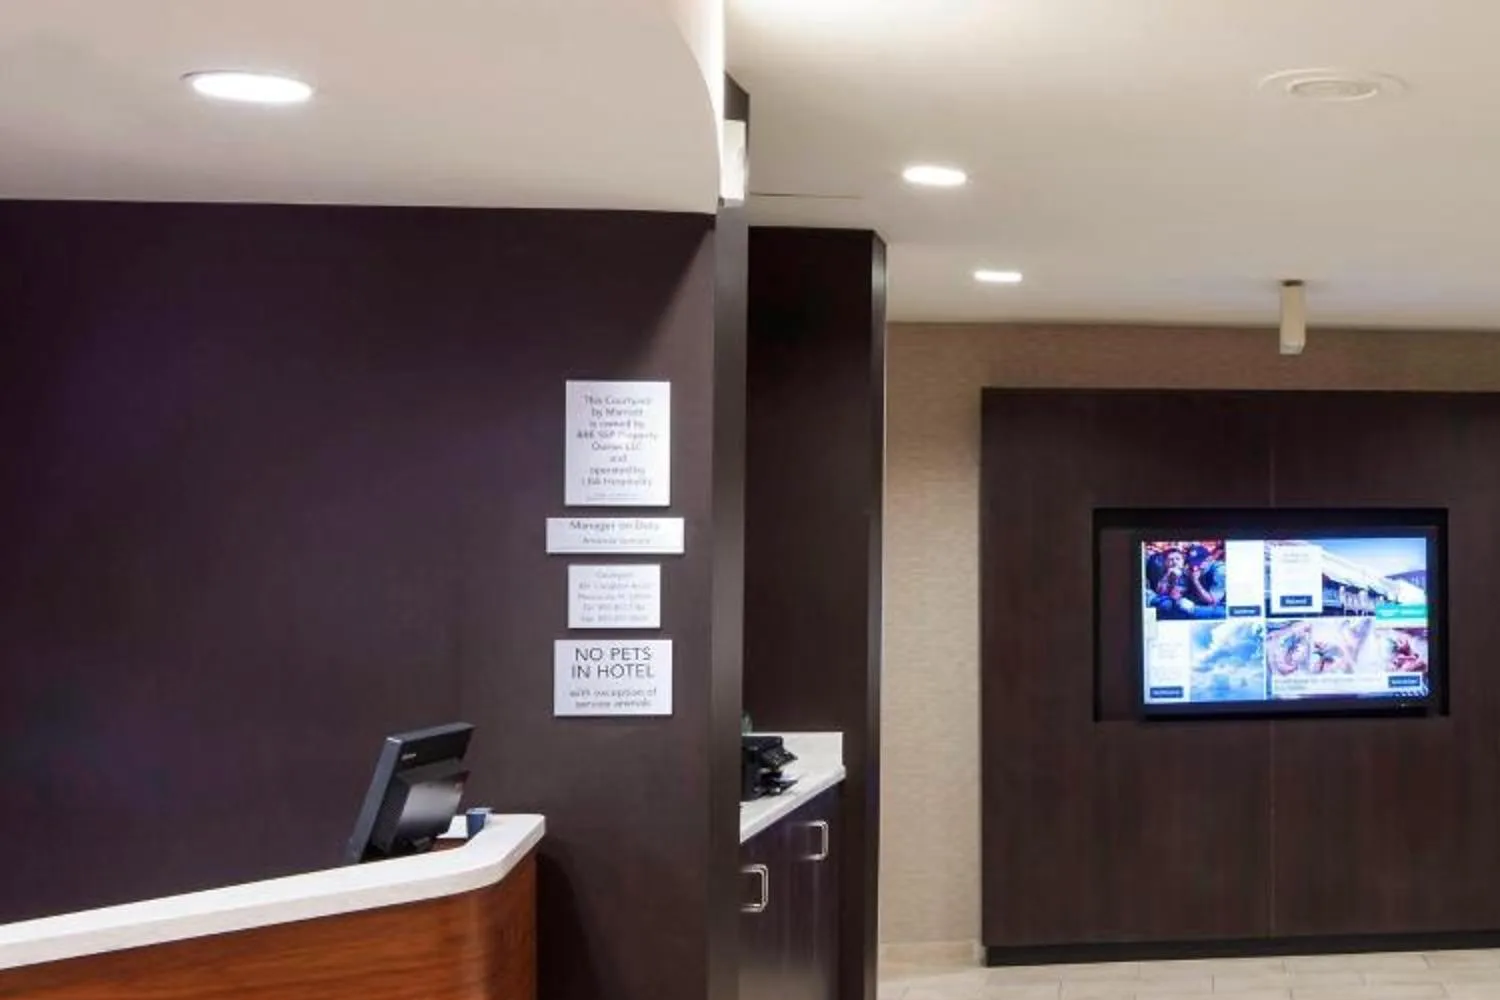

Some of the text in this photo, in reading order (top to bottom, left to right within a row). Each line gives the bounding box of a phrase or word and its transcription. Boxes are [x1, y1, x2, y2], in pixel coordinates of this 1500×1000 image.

[575, 646, 652, 662] NO PETS
[571, 663, 656, 679] IN HOTEL
